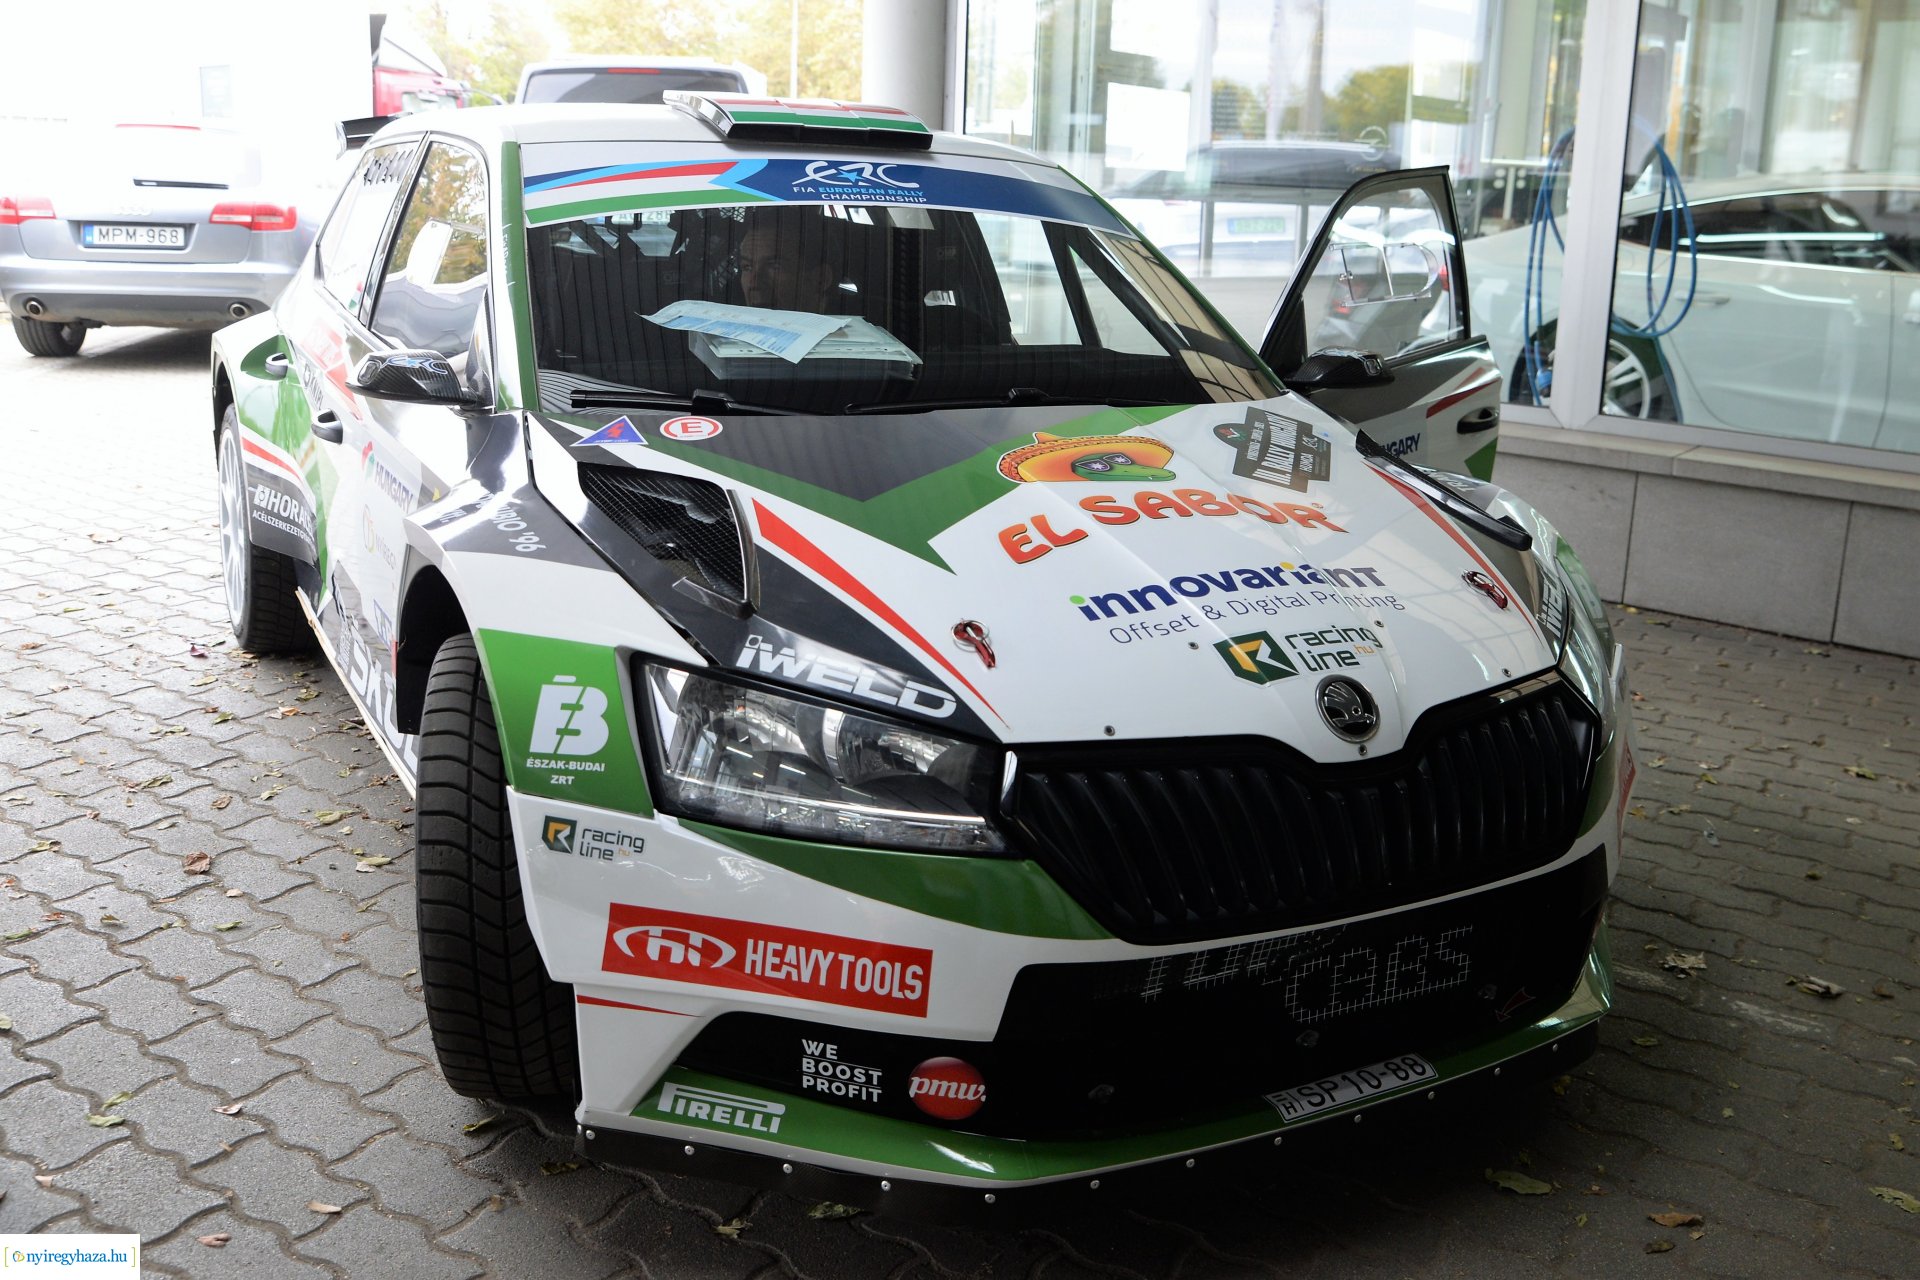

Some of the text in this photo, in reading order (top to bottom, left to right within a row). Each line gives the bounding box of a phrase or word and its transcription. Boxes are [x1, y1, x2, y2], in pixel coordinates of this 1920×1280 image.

[818, 187, 885, 195] EUROPEAN
[887, 189, 924, 197] RALLY
[821, 194, 927, 203] CHAMPIONSHIP
[98, 228, 179, 244] MPM-968
[680, 421, 704, 435] E
[1261, 444, 1295, 473] RALLY
[374, 461, 414, 515] HUNGARY
[998, 488, 1350, 564] EL SABOR
[1109, 587, 1404, 644] Offset & Digital Printing
[1284, 624, 1383, 650] racing
[1296, 648, 1360, 672] line
[526, 756, 606, 772] ÉSZAK-BUDAI
[550, 775, 575, 785] ZRT
[579, 841, 614, 861] line
[581, 828, 645, 853] racing
[801, 1038, 838, 1061] WE
[802, 1058, 883, 1085] BOOST
[802, 1074, 883, 1103] PROFIT
[657, 1081, 786, 1134] PIRELLI
[1281, 1101, 1298, 1116] H
